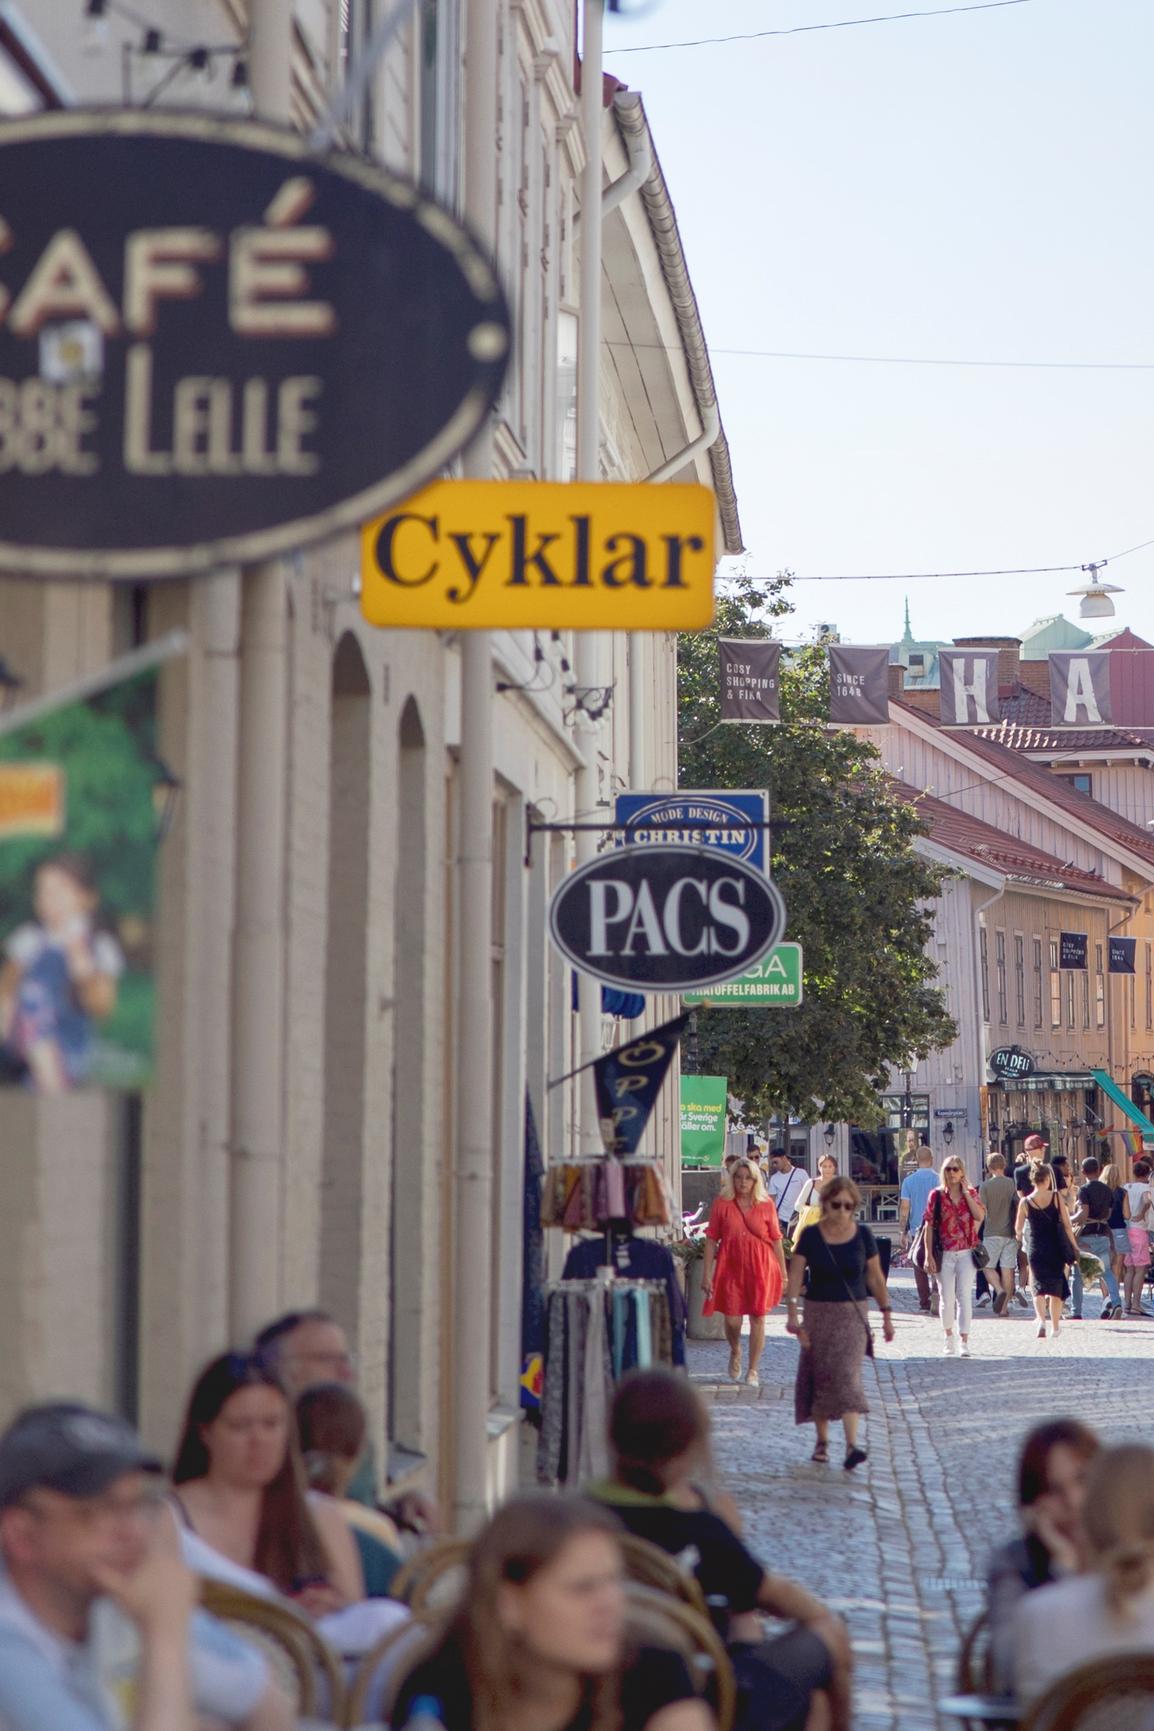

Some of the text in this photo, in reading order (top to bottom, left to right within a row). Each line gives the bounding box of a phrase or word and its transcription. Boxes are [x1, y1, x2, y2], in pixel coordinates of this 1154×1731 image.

[0, 178, 336, 338] AFÉ
[373, 513, 705, 604] Cyklar
[726, 662, 751, 675] COSY
[726, 676, 775, 689] SHOPPING
[836, 672, 865, 686] SINCE
[738, 689, 761, 701] FIKA
[952, 658, 990, 724] H
[1063, 658, 1102, 723] A
[650, 807, 731, 824] MODE DESIGN
[633, 829, 746, 845] CHRISTIN
[586, 876, 751, 957] PACS
[781, 983, 795, 996] AB
[687, 1111, 719, 1124] Sverige
